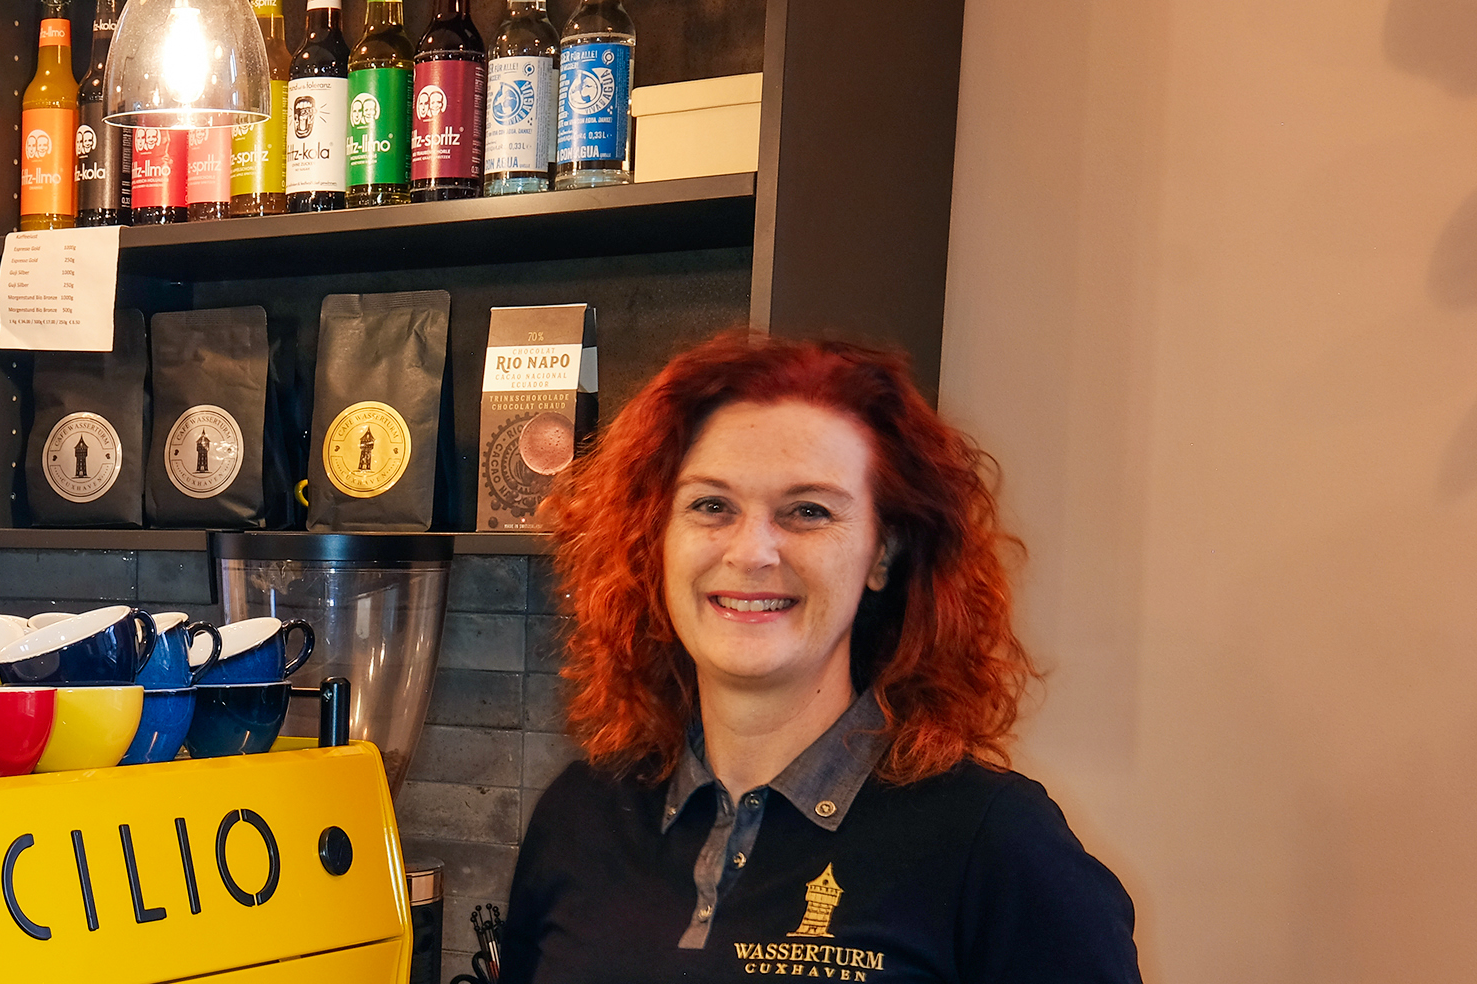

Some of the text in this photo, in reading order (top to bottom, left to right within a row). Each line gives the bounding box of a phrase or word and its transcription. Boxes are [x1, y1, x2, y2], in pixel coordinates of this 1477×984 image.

[346, 134, 390, 155] itz-limo
[411, 126, 460, 150] itz-spritz
[588, 132, 602, 140] 0,33
[287, 142, 330, 162] itz-kola
[509, 142, 521, 150] 0,33
[22, 167, 62, 186] itz-limo
[74, 162, 105, 182] tz-kola
[132, 160, 171, 178] itz-limo
[528, 331, 544, 341] 70%
[496, 353, 570, 373] RIO NAPO
[525, 372, 567, 380] NACIONAL
[490, 394, 569, 402] TRINKSCHOKOLADE
[492, 403, 535, 411] CHOCOLAT
[68, 422, 110, 445] WASSERTURM
[506, 424, 524, 438] RIO
[491, 443, 503, 484] CACAO
[734, 942, 885, 970] WASSERTURM
[744, 962, 866, 982] CUXHAVEN
